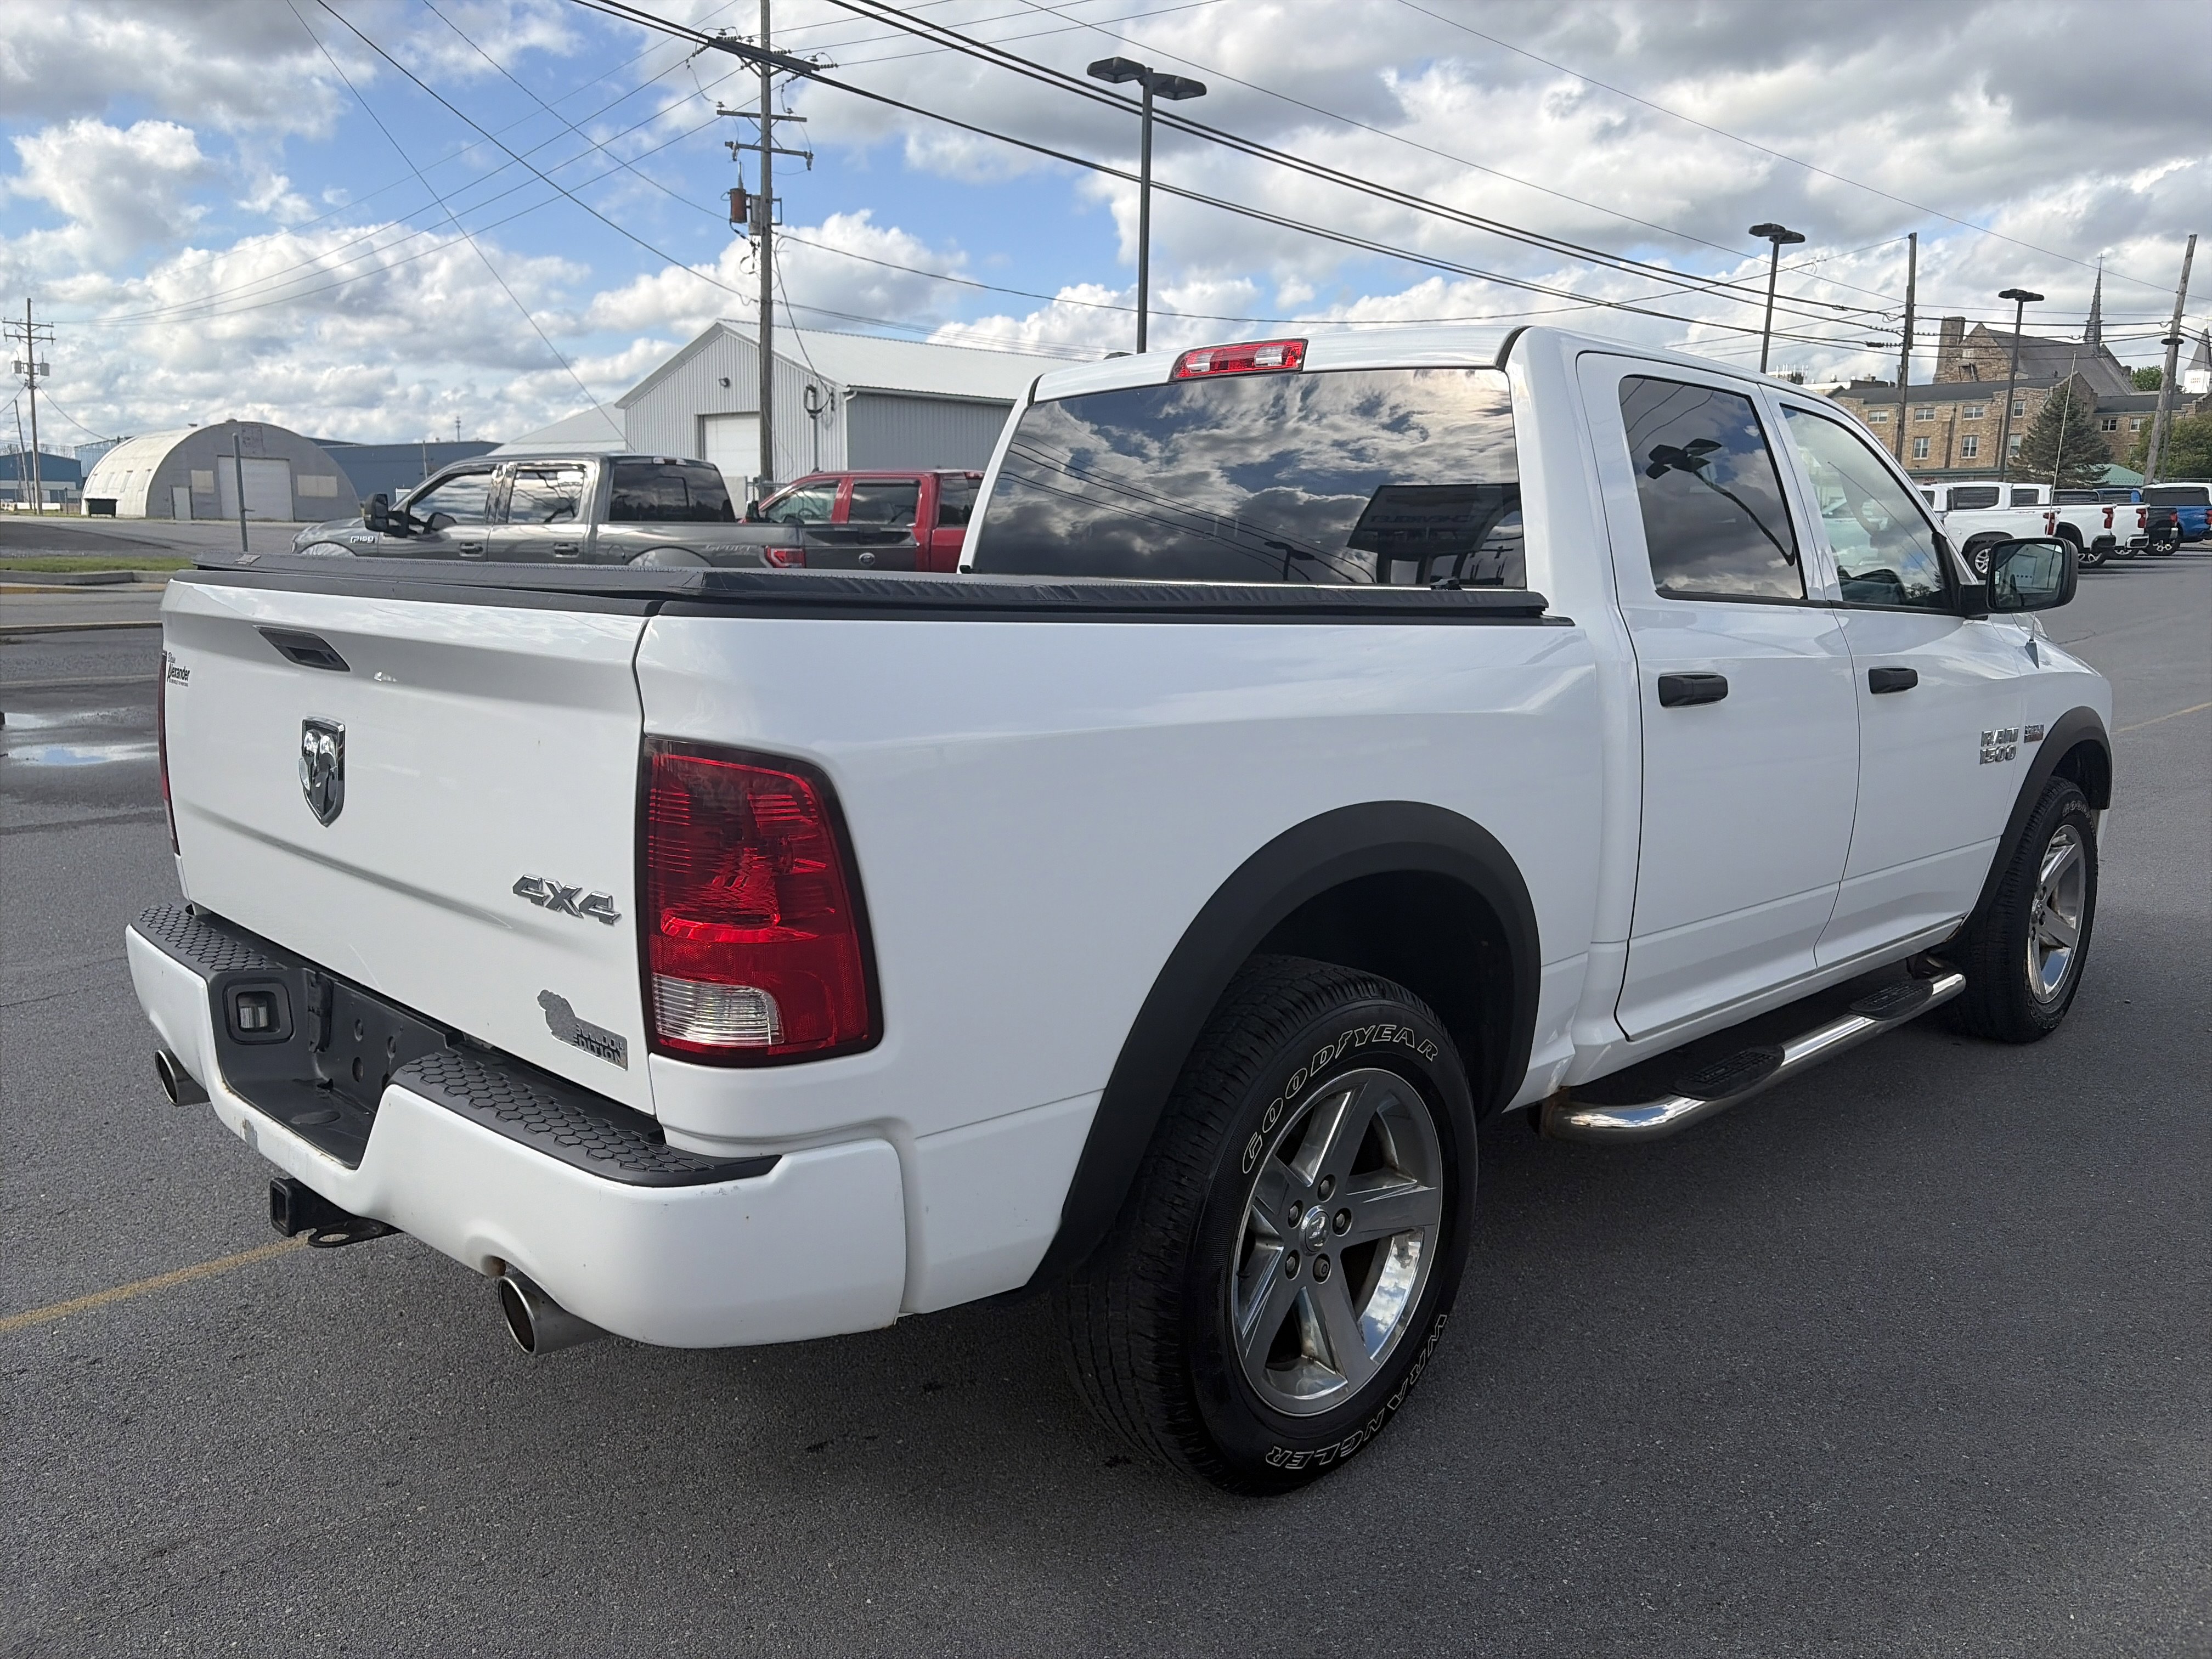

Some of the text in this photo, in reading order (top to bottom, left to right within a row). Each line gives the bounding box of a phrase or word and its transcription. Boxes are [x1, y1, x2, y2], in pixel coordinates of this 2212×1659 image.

[167, 663, 190, 682] Alexander
[1979, 744, 2017, 765] 1500
[573, 1034, 622, 1063] EDITION
[575, 1023, 624, 1051] BULLDOG
[1242, 1024, 1439, 1174] GOODYEAR
[1265, 1314, 1448, 1469] WRANGLER
